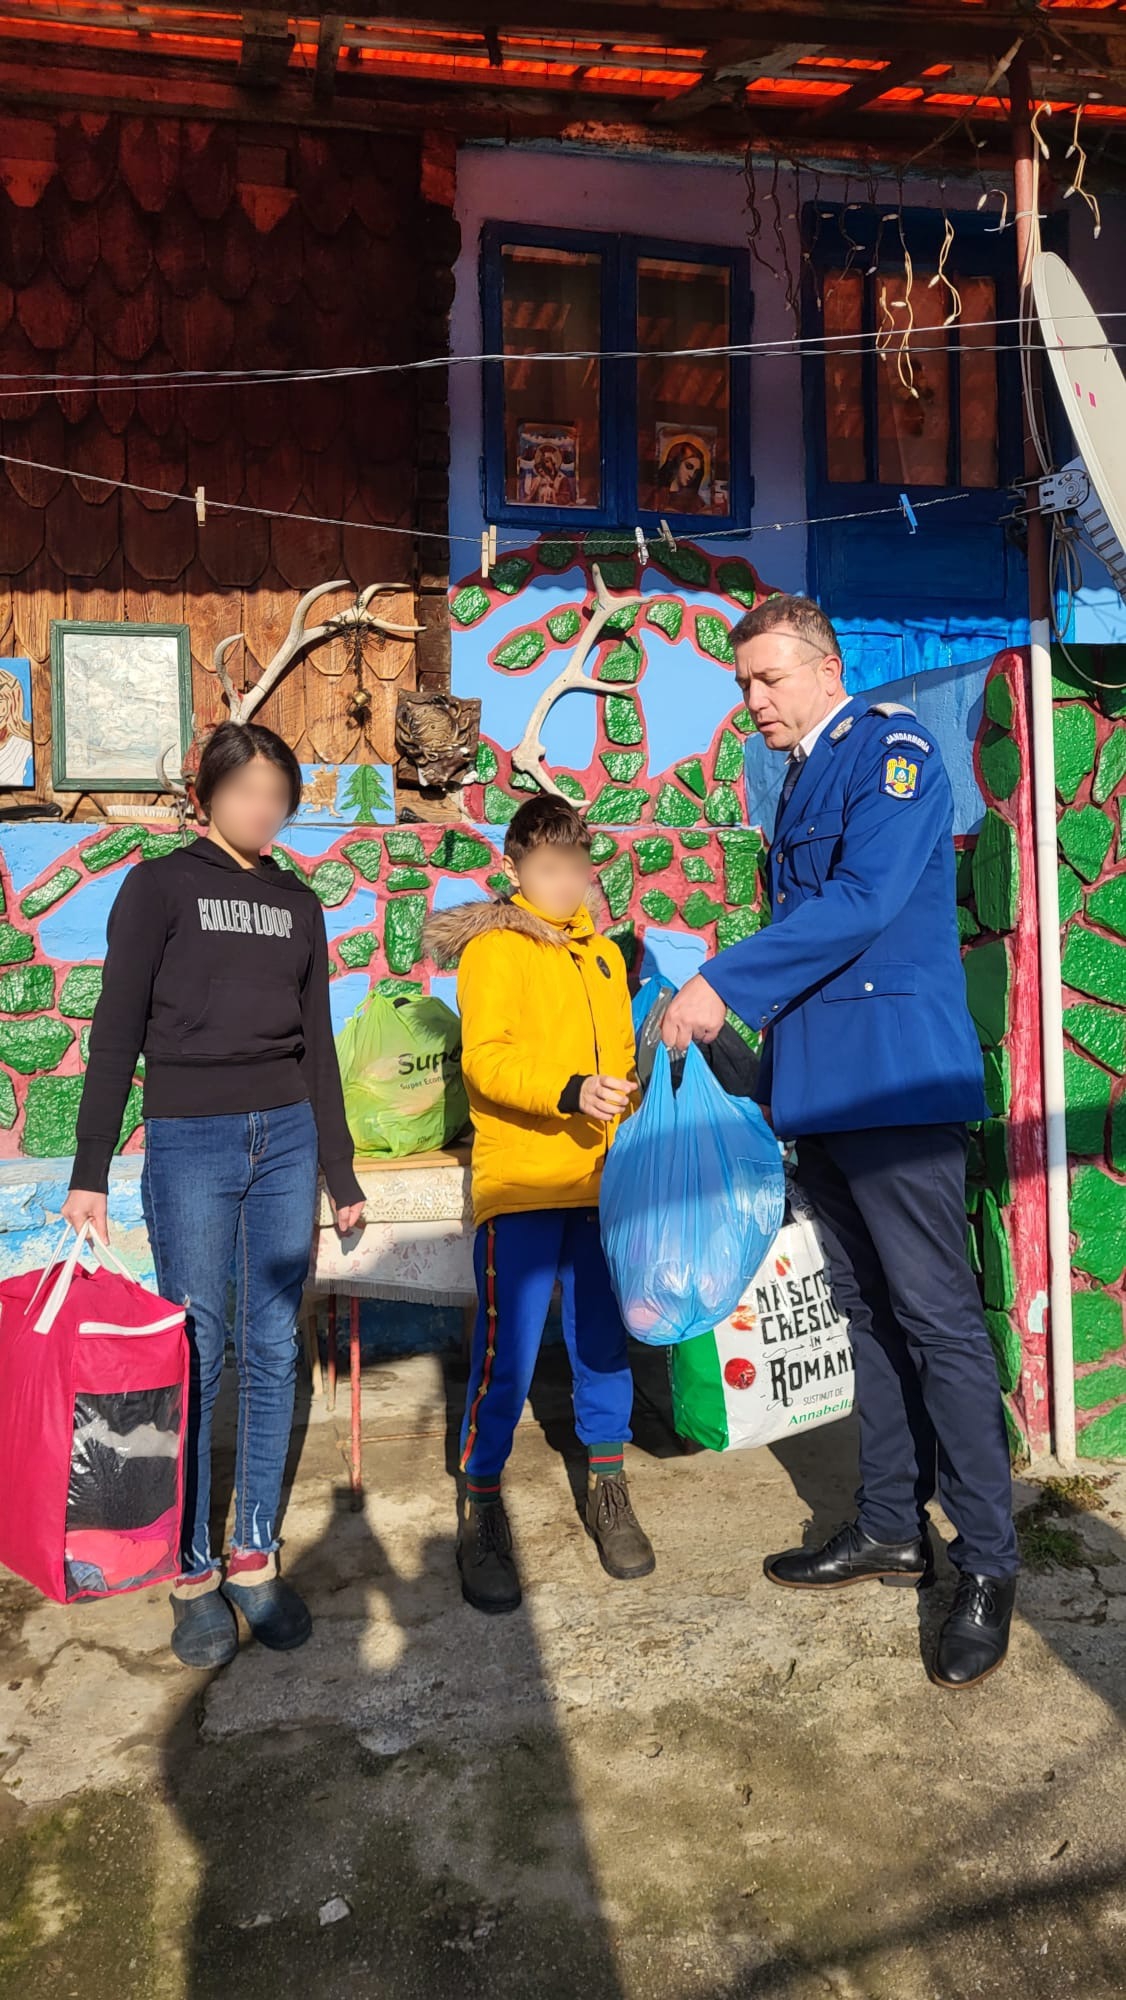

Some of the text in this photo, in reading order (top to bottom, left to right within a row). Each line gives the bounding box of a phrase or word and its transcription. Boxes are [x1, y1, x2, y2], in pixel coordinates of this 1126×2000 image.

[886, 732, 930, 752] JANDARMERIA
[198, 898, 293, 938] KILLER LOOP
[834, 1387, 844, 1398] DE
